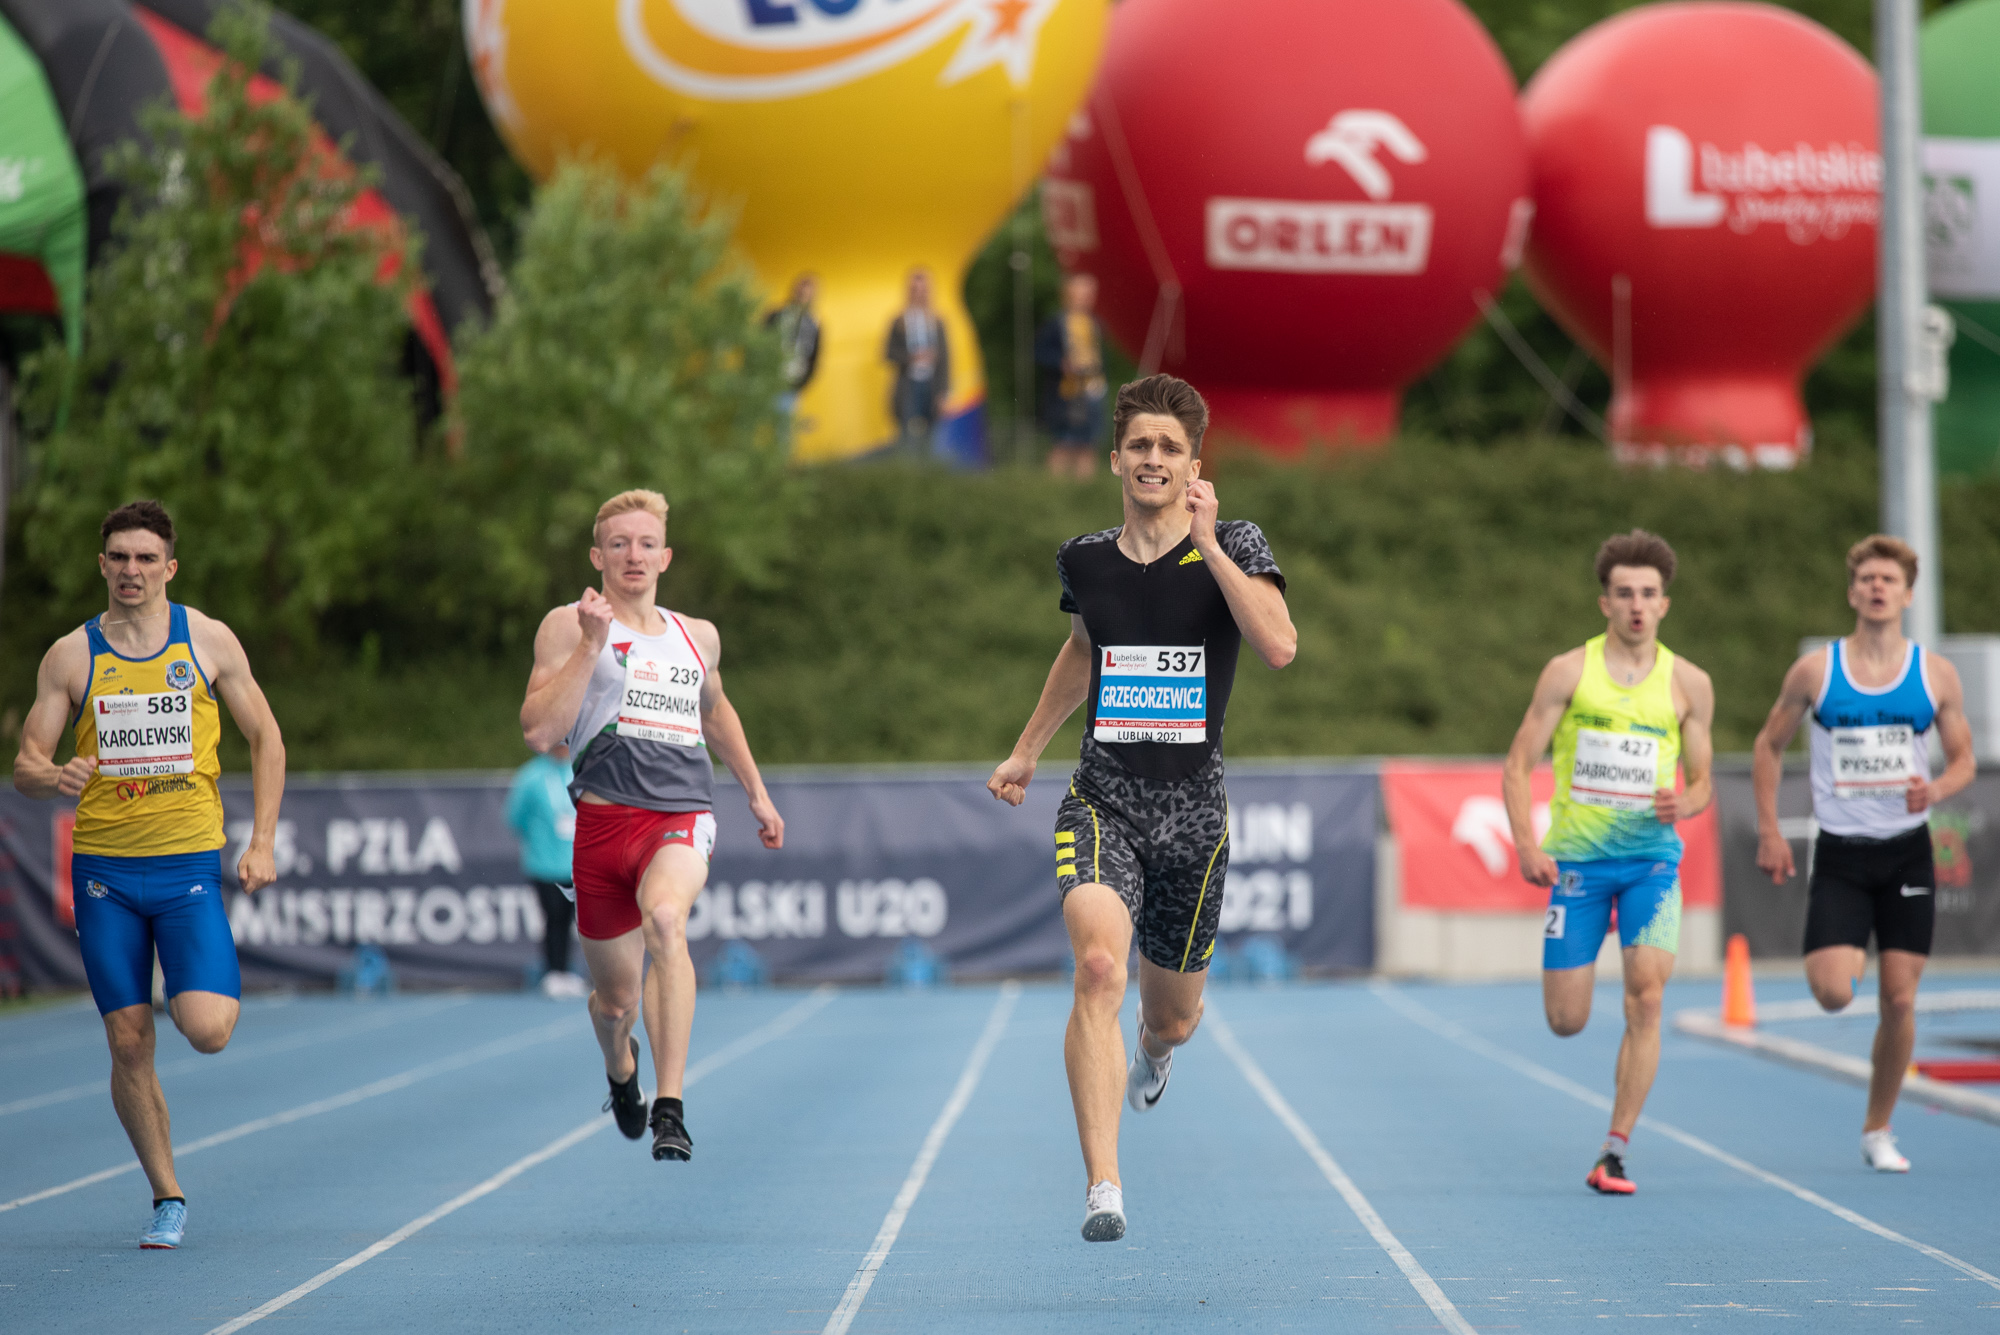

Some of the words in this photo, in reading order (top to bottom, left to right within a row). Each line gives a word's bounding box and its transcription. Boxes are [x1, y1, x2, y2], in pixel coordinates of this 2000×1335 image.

[1224, 213, 1414, 256] ORLEN
[1157, 651, 1202, 672] 537
[670, 666, 699, 686] 239
[147, 695, 187, 715] 583
[626, 689, 697, 718] SZCZEPANIAK
[1101, 685, 1203, 709] GRZEGORZEWICZ
[99, 725, 191, 748] KAROLEWSKI
[638, 728, 665, 740] LUBLIN
[667, 732, 684, 743] 2021
[1117, 730, 1153, 740] LUBLIN
[1157, 731, 1182, 742] 2021
[1619, 739, 1652, 757] 427
[119, 765, 150, 776] LUBLIN
[153, 764, 175, 774] 2021
[1840, 756, 1905, 773] PYSZKA
[326, 816, 462, 876] PZLA
[684, 880, 826, 941] OLSKI
[836, 877, 947, 938] U20
[1545, 909, 1558, 934] 2
